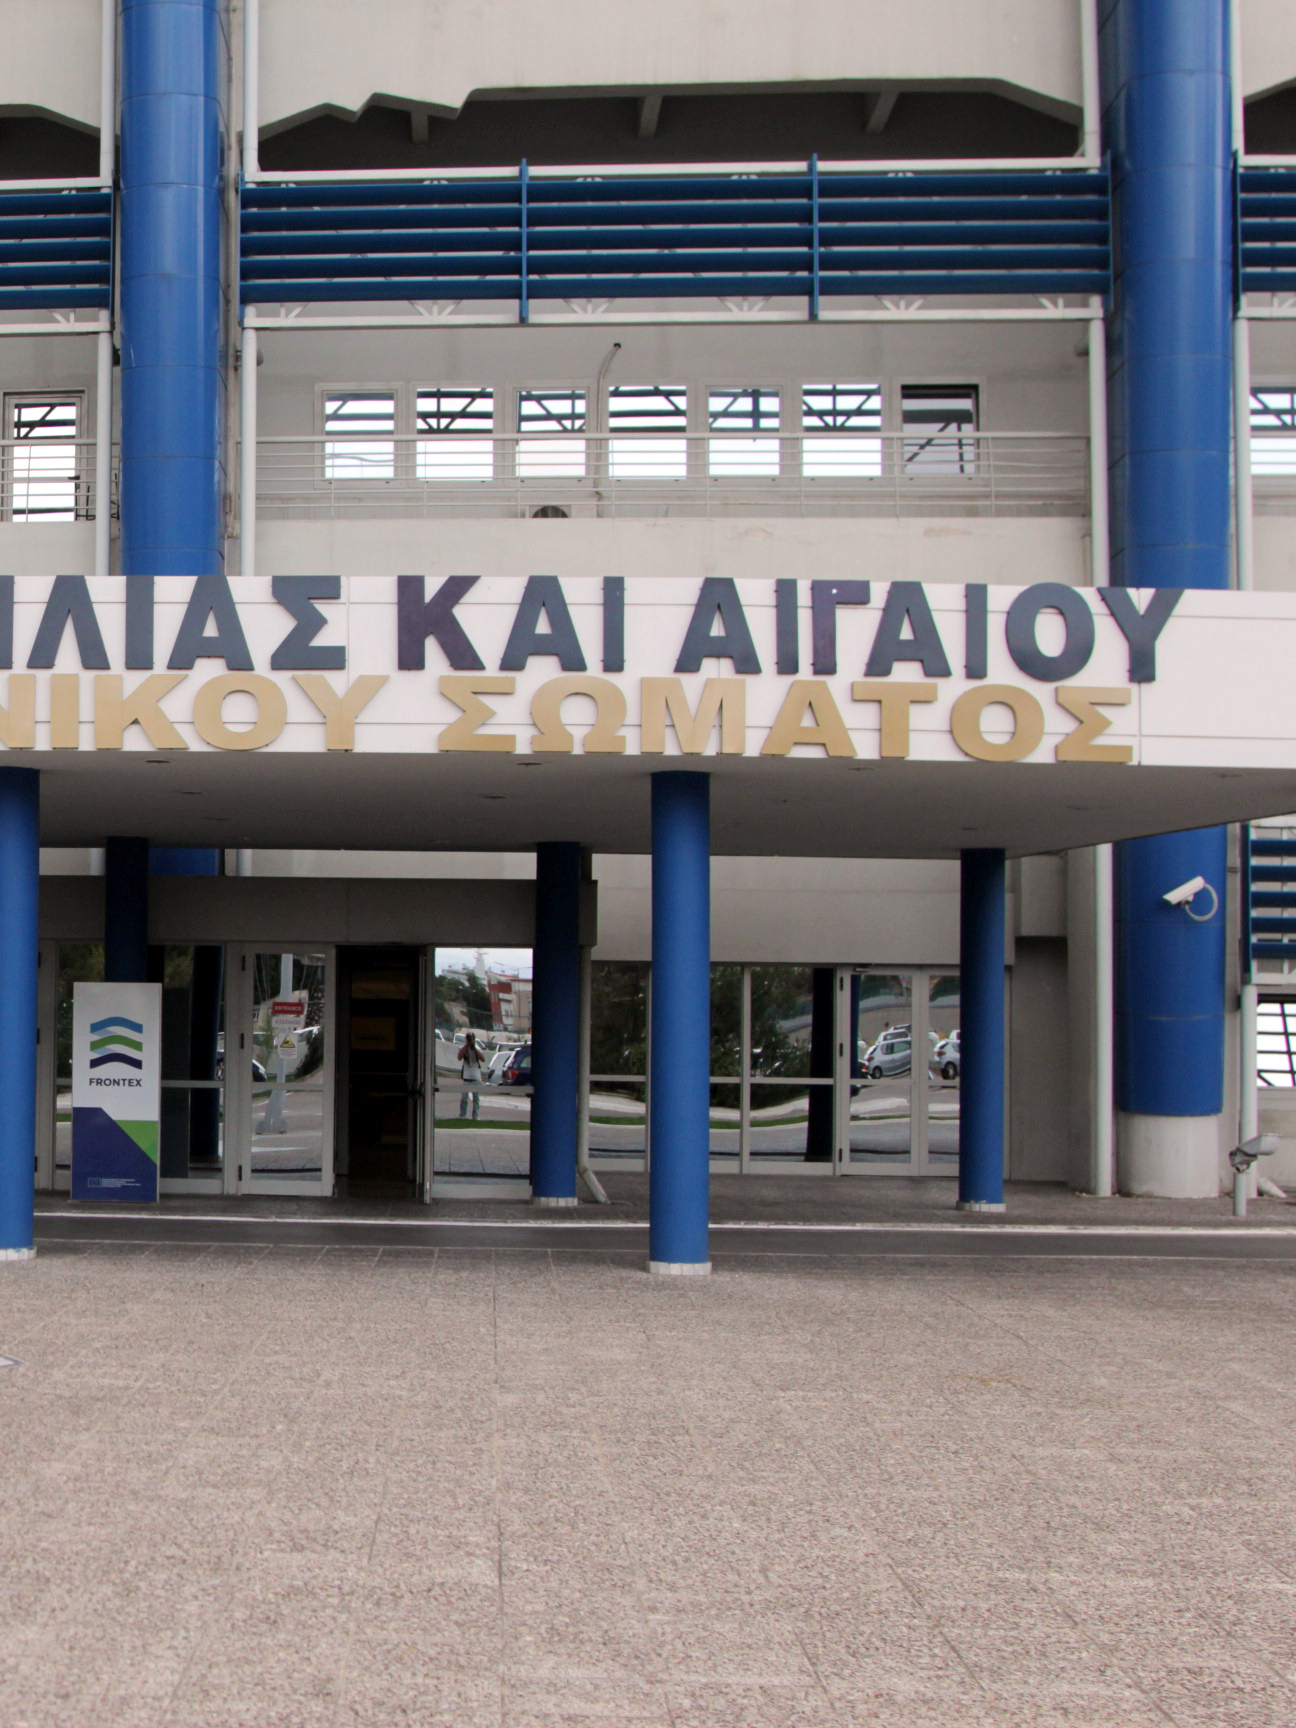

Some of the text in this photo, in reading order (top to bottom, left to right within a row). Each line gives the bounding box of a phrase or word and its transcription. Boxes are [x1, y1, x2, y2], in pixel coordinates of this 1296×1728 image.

[397, 575, 625, 673] ΚΑΙ
[674, 577, 1184, 684] ΑΙΓΑΙΟΥ
[438, 675, 1134, 763] ΣΩΜΑΤΟΣ
[89, 1077, 142, 1087] FRONTEX
